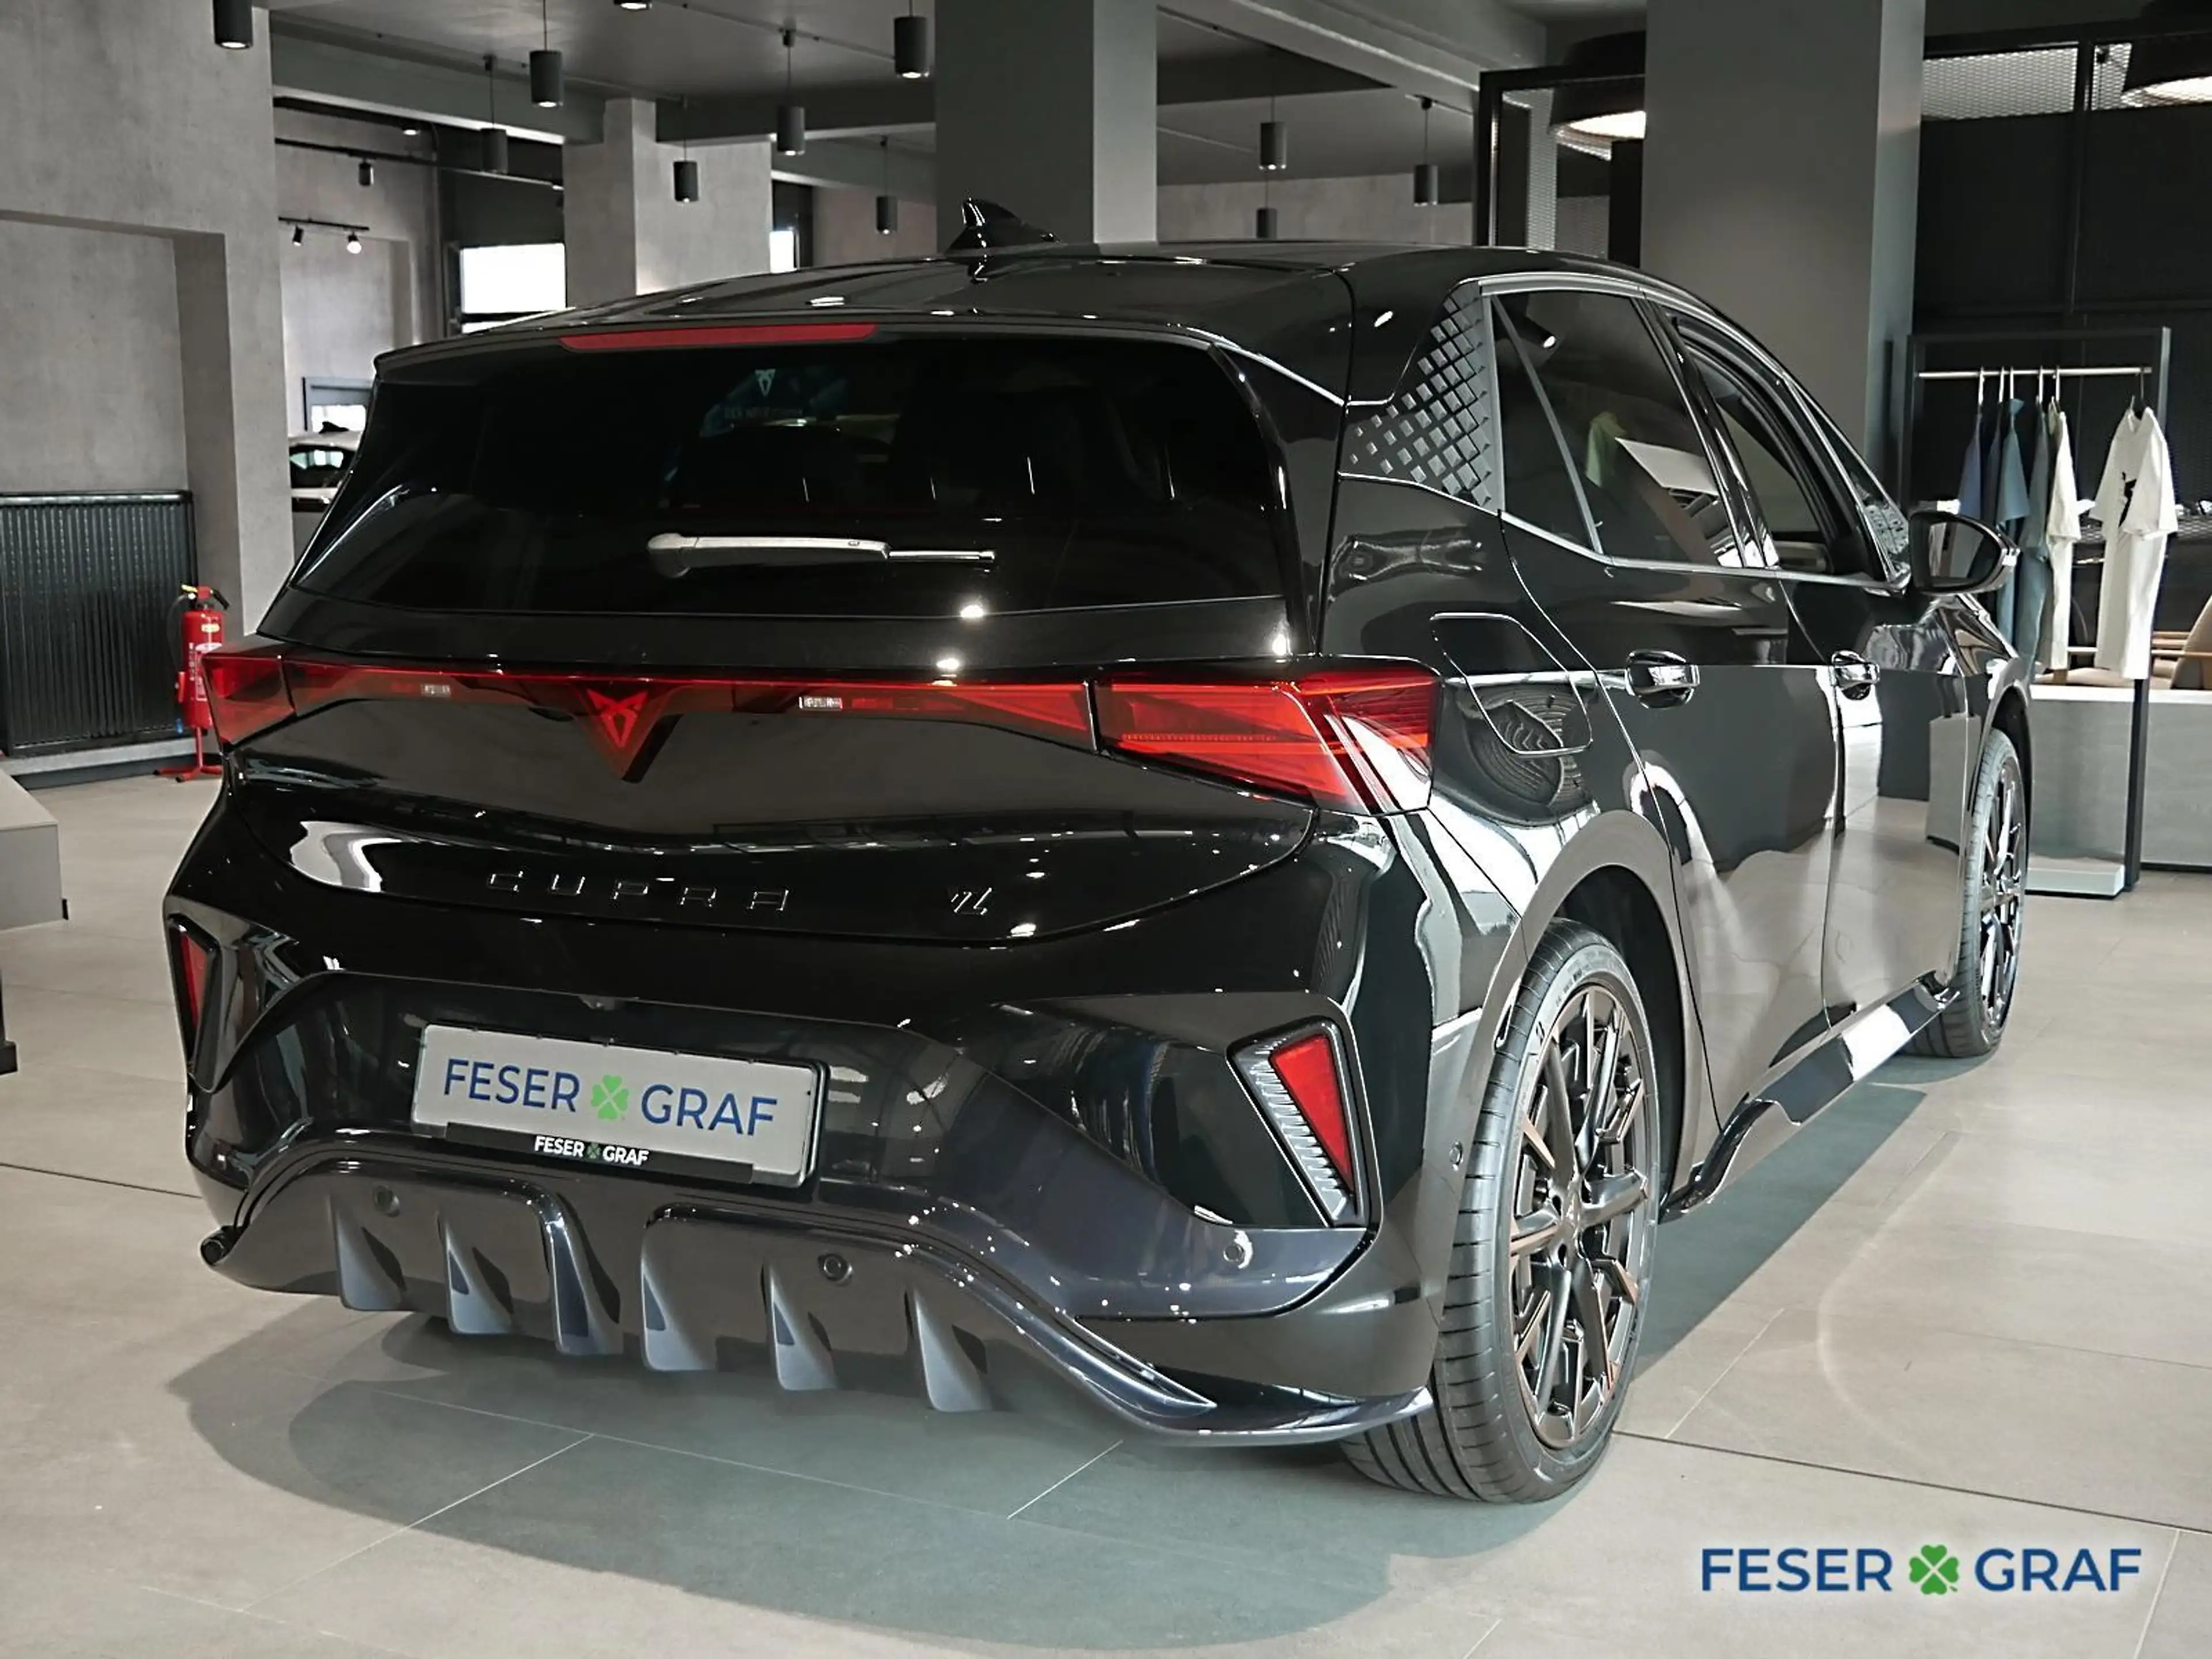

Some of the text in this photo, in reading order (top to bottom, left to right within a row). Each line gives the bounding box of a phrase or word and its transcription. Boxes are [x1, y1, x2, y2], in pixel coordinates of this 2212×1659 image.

[487, 870, 789, 911] CUPRA
[444, 1058, 778, 1137] FESER GRAF
[534, 1135, 649, 1166] FESER GRAF
